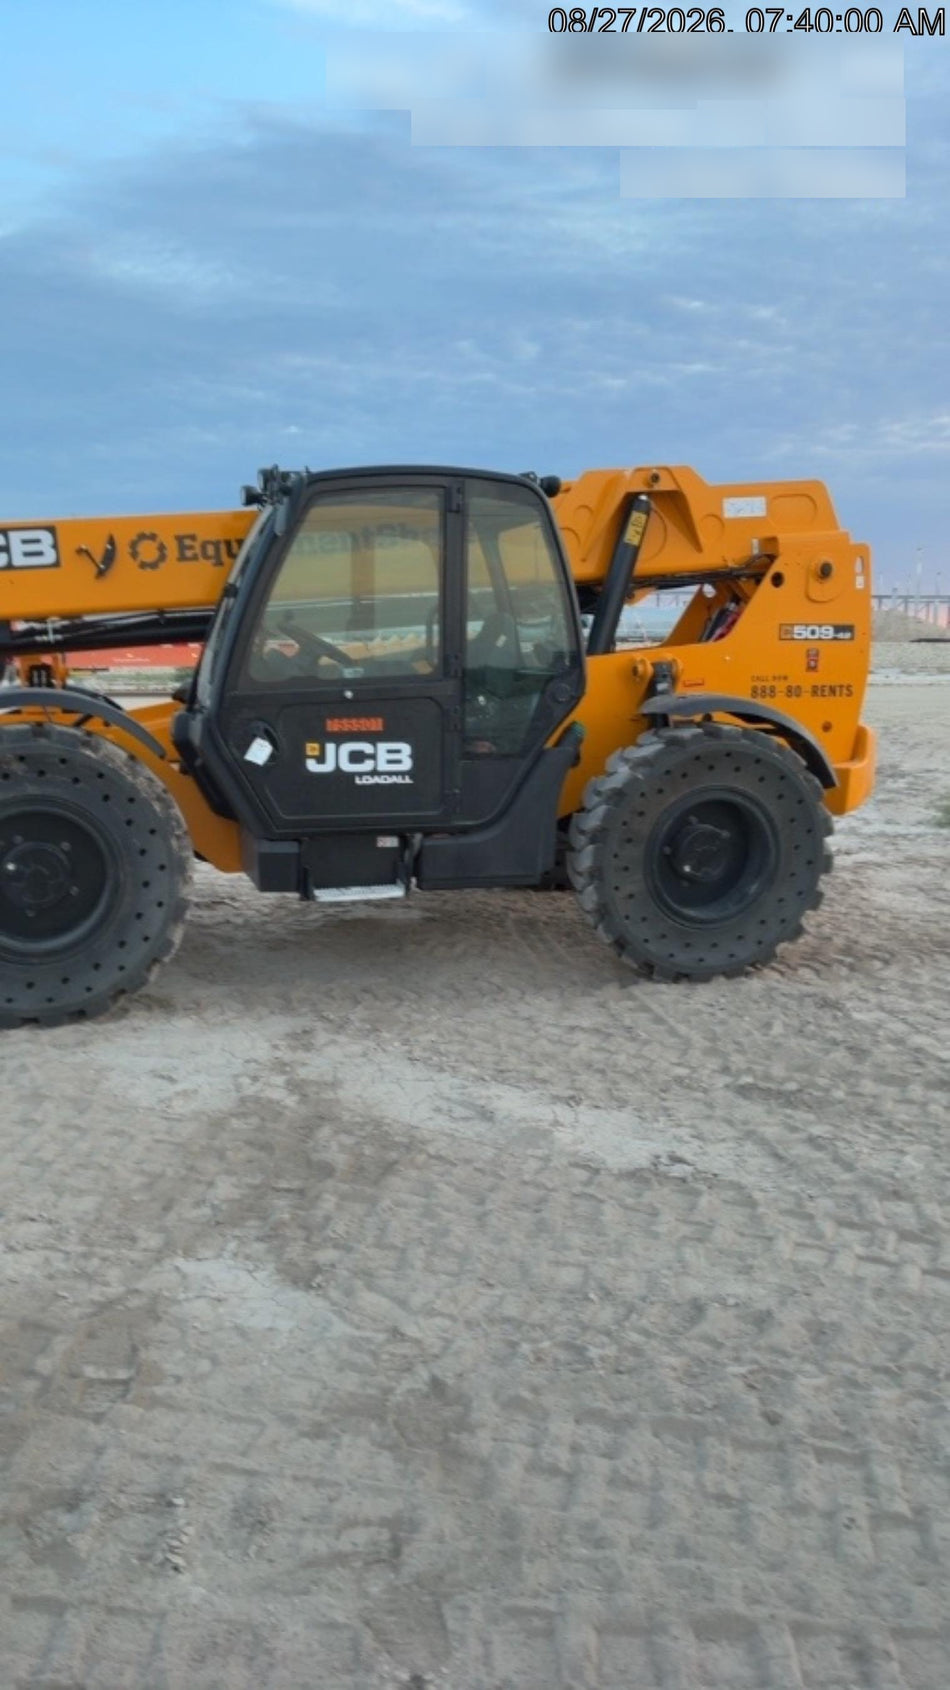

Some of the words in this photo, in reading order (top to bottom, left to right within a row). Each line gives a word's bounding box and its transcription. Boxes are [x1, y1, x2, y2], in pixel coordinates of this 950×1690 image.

[0, 530, 57, 568] B
[306, 742, 413, 773] JCB
[354, 774, 414, 785] LOADALL
